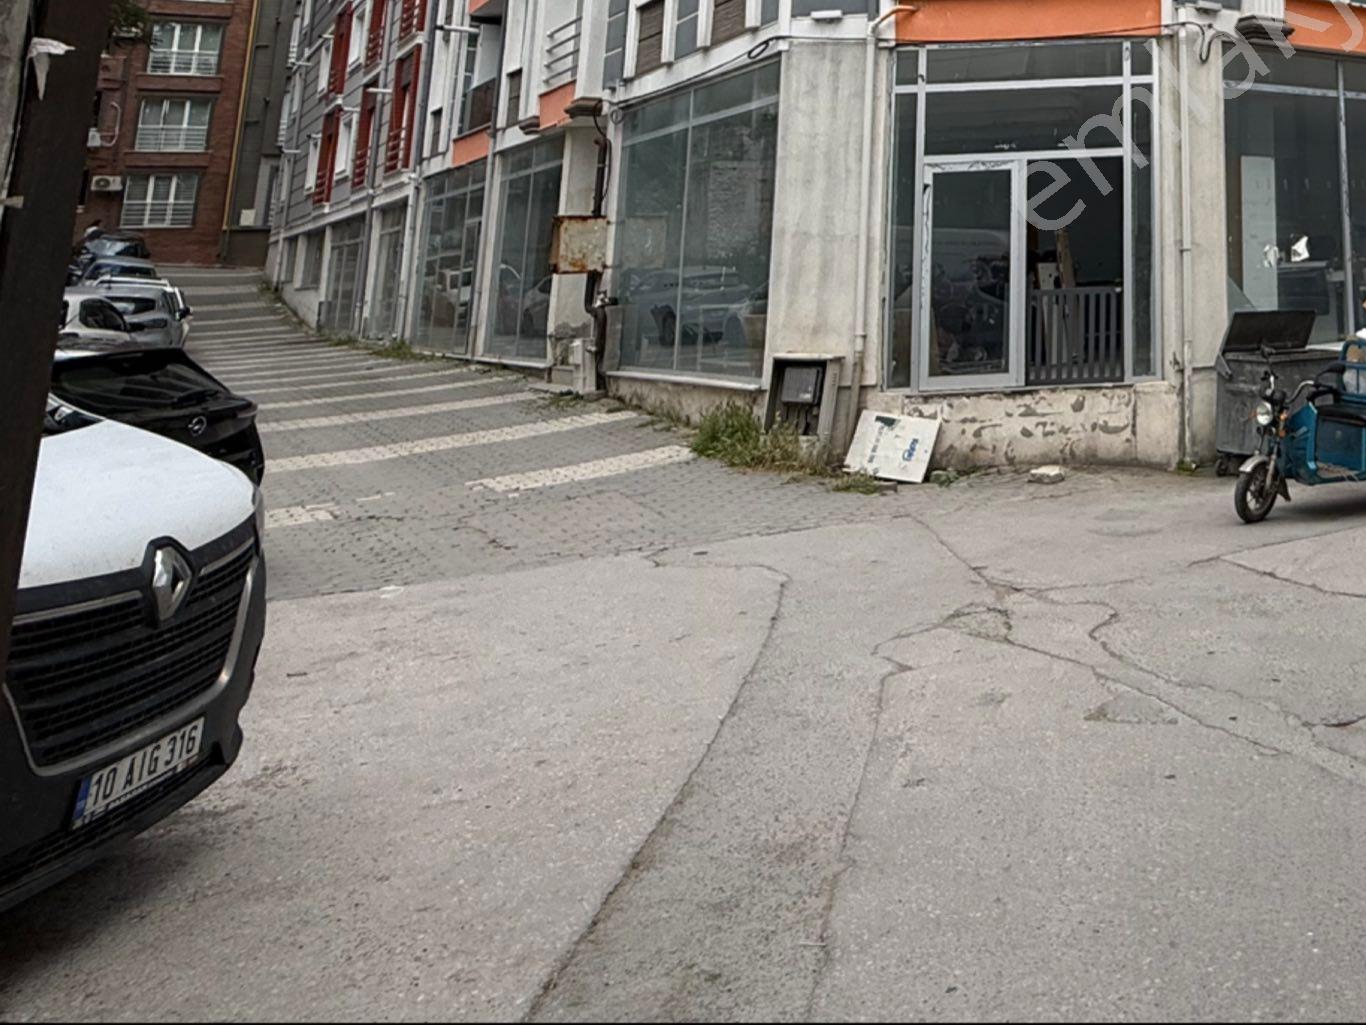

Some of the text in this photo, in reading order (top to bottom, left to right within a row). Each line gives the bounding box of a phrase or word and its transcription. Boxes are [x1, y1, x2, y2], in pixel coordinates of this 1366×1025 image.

[93, 725, 198, 807] 10 AIG 316
